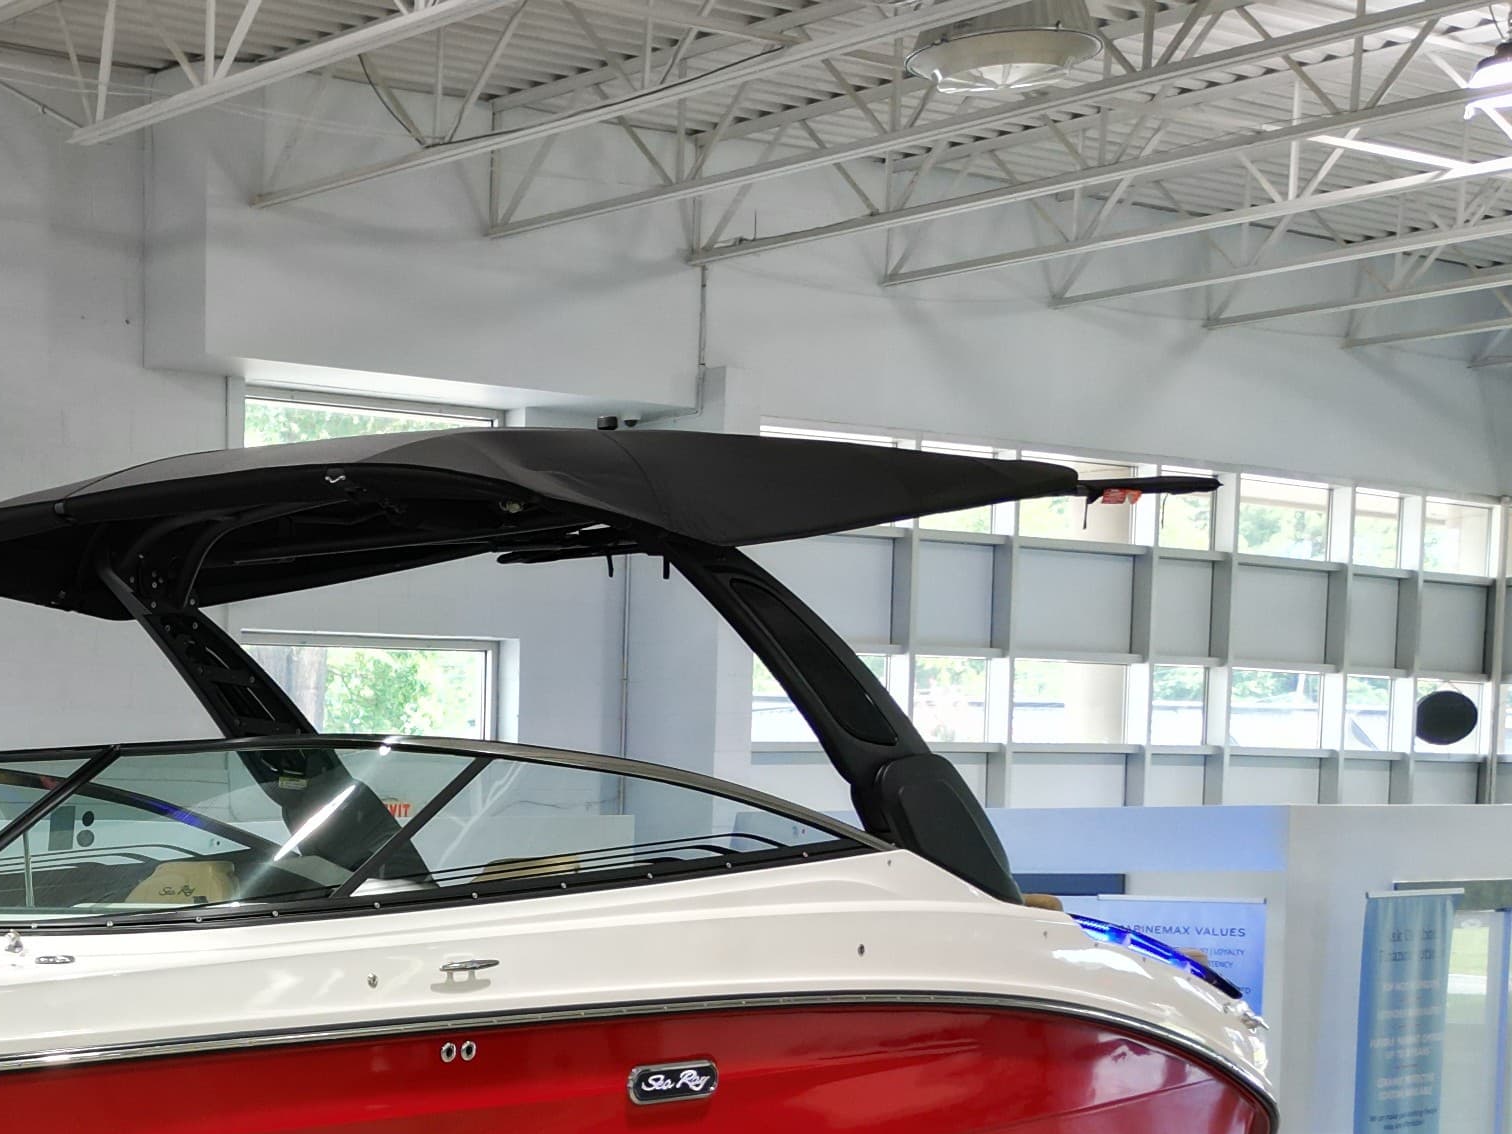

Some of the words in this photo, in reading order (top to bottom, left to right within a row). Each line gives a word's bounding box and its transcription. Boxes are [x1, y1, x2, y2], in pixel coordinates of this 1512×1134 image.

[383, 802, 411, 817] XIT
[1119, 924, 1190, 935] RINEMAX
[1195, 927, 1246, 937] VALUES
[641, 1074, 675, 1091] Sea
[675, 1069, 710, 1091] Ray
